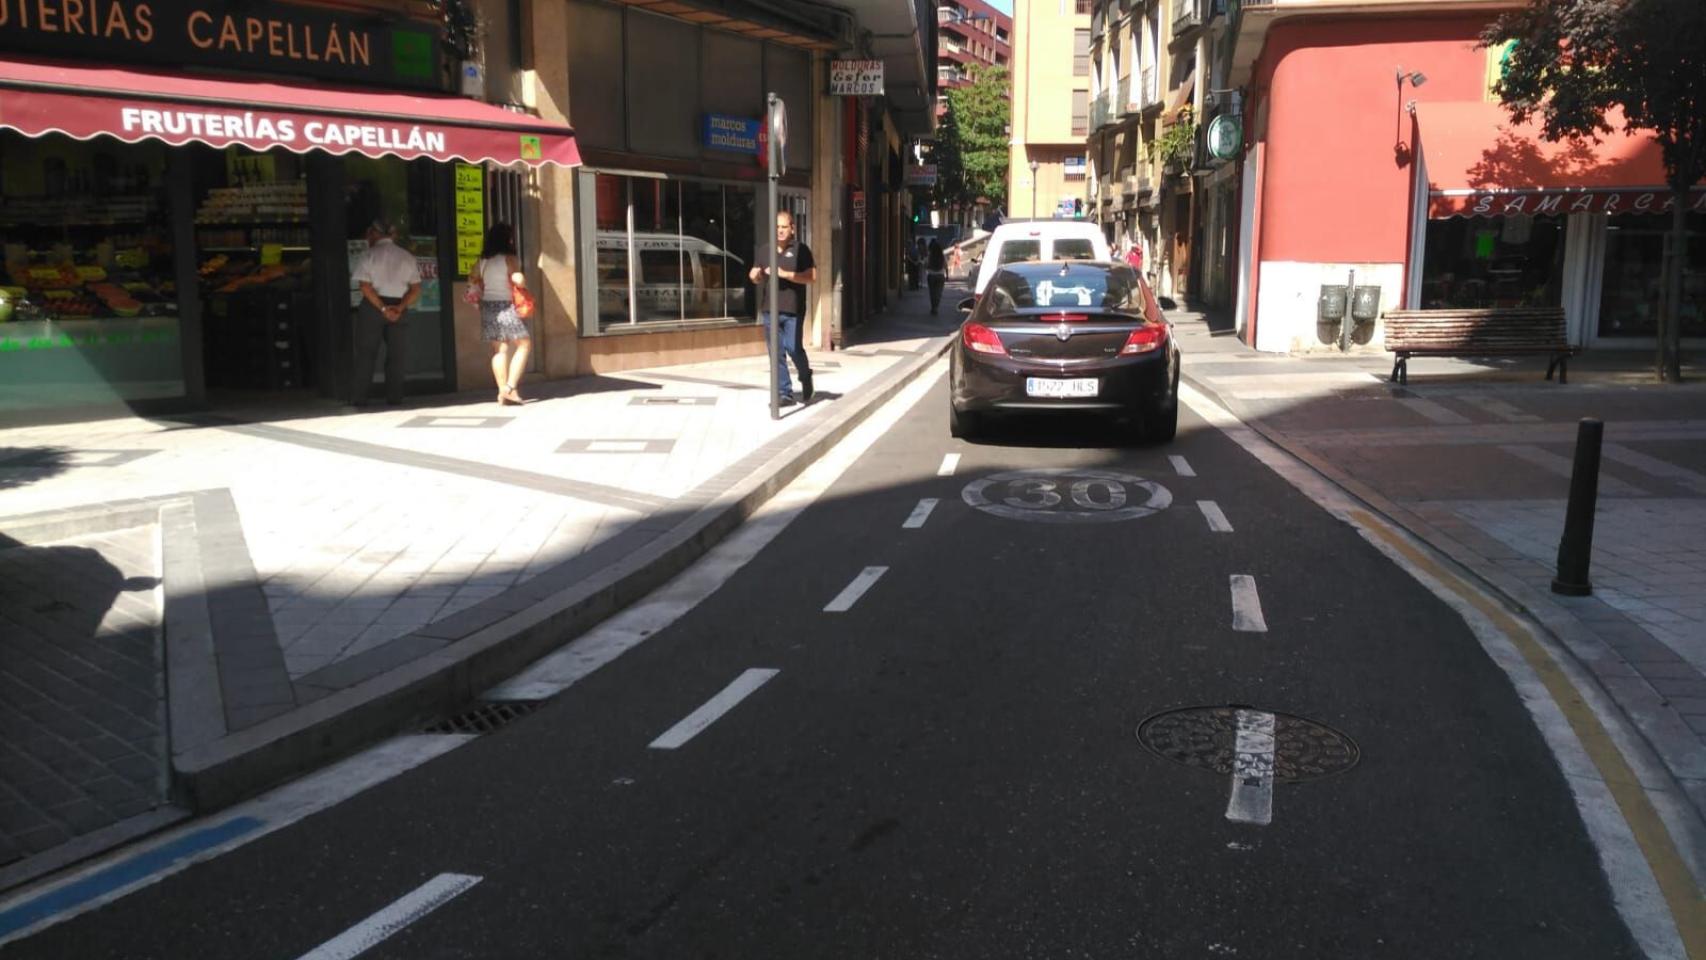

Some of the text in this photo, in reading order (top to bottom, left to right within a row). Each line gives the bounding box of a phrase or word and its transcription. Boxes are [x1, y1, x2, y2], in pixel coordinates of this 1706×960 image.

[187, 10, 370, 66] CAPELLÁN
[832, 60, 880, 71] MOLDURAS
[831, 82, 874, 93] MARCOS
[121, 107, 445, 152] FRUTERÍAS CAPELLÁN
[711, 116, 746, 132] marcos
[711, 132, 756, 149] molduras
[1003, 478, 1127, 510] 30
